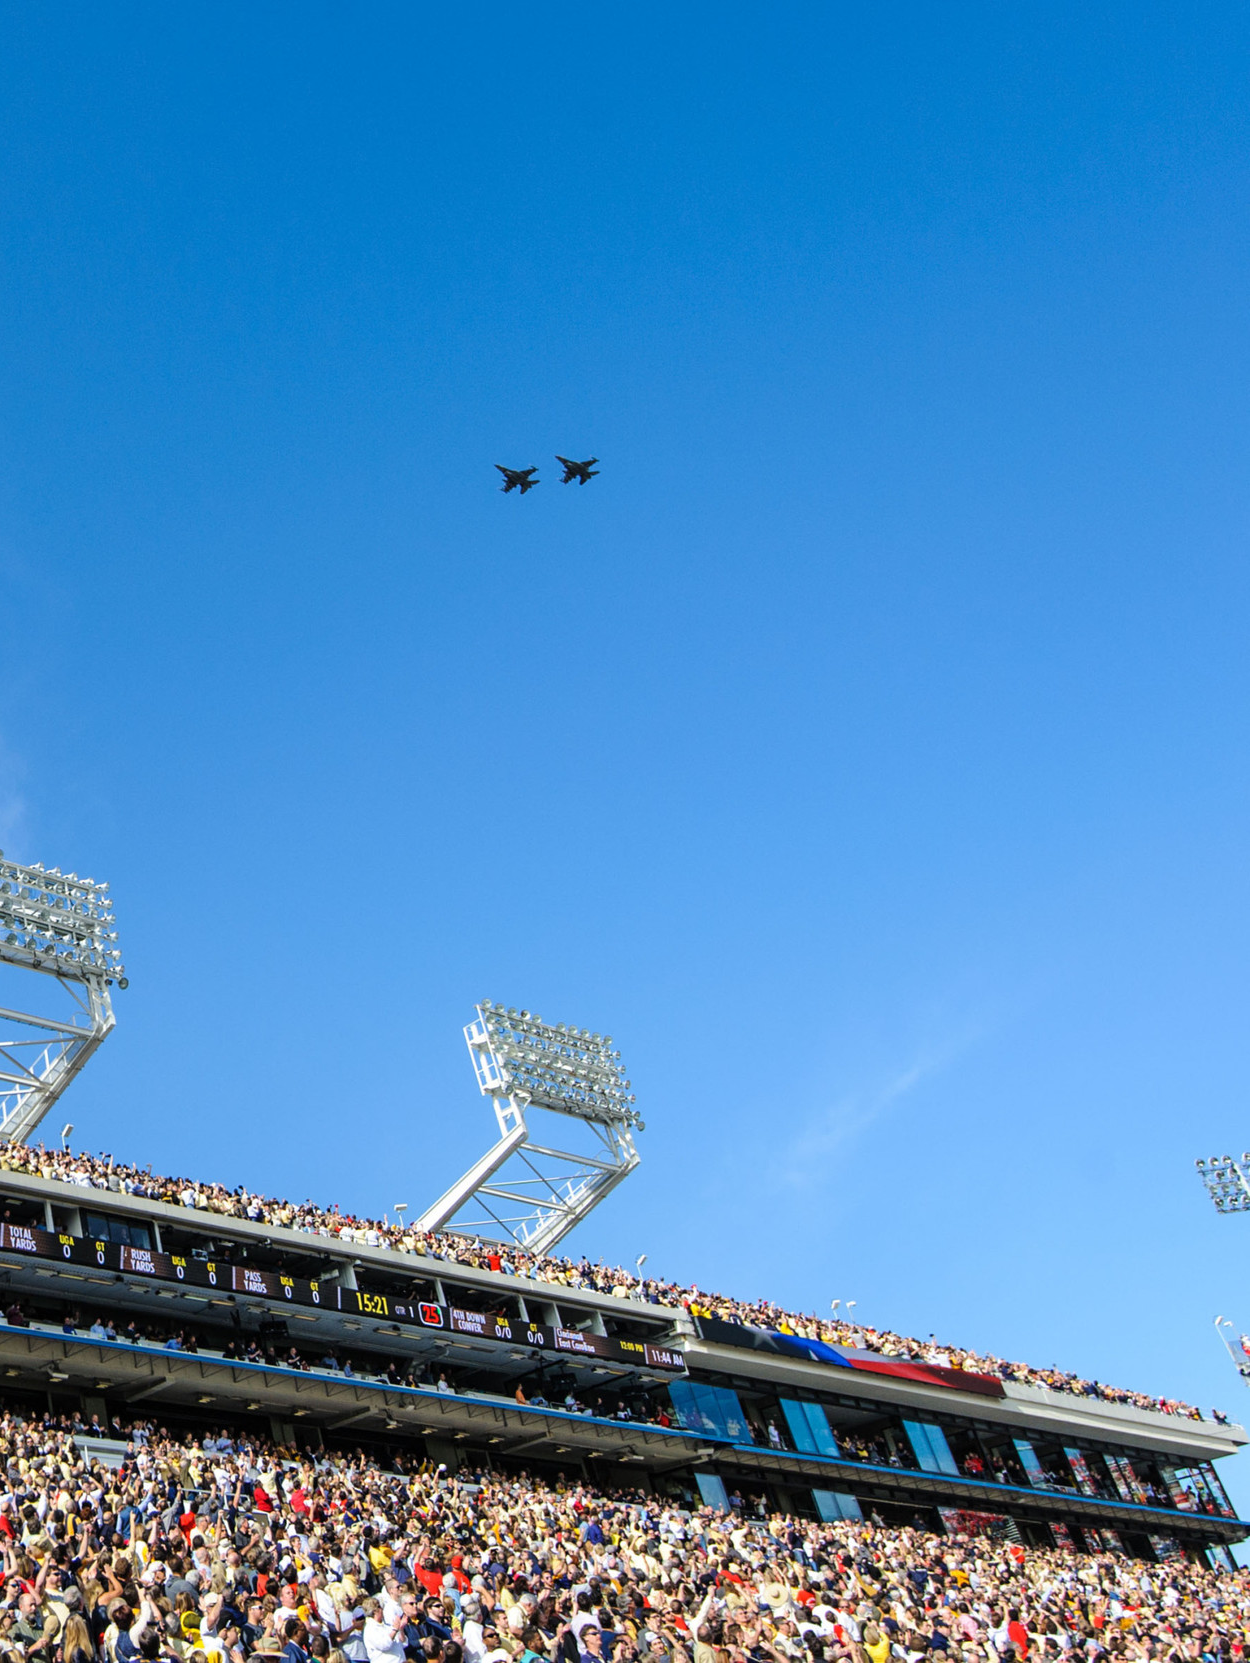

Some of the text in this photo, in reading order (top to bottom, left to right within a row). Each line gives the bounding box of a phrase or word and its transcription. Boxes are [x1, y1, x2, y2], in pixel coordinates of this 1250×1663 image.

[9, 1226, 33, 1240] TOTAL
[10, 1237, 36, 1251] YARDS
[59, 1234, 105, 1251] UGA GT
[63, 1245, 104, 1264] 0 0
[131, 1249, 151, 1262] RUSH
[131, 1260, 155, 1273] YARDS
[172, 1256, 216, 1272] UGA GT
[177, 1266, 216, 1285] 0 0
[245, 1270, 262, 1282] PASS
[244, 1280, 267, 1293] YARDS
[280, 1276, 319, 1291] UGA GT
[285, 1286, 319, 1303] 0 0
[356, 1292, 388, 1315] 15:21
[409, 1307, 414, 1318] 1
[422, 1305, 439, 1323] 25
[454, 1310, 486, 1324] 4TH DOWN
[496, 1317, 537, 1332] UGA GT
[495, 1325, 544, 1344] 0/0 0/0
[652, 1350, 684, 1366] 11:44 AM
